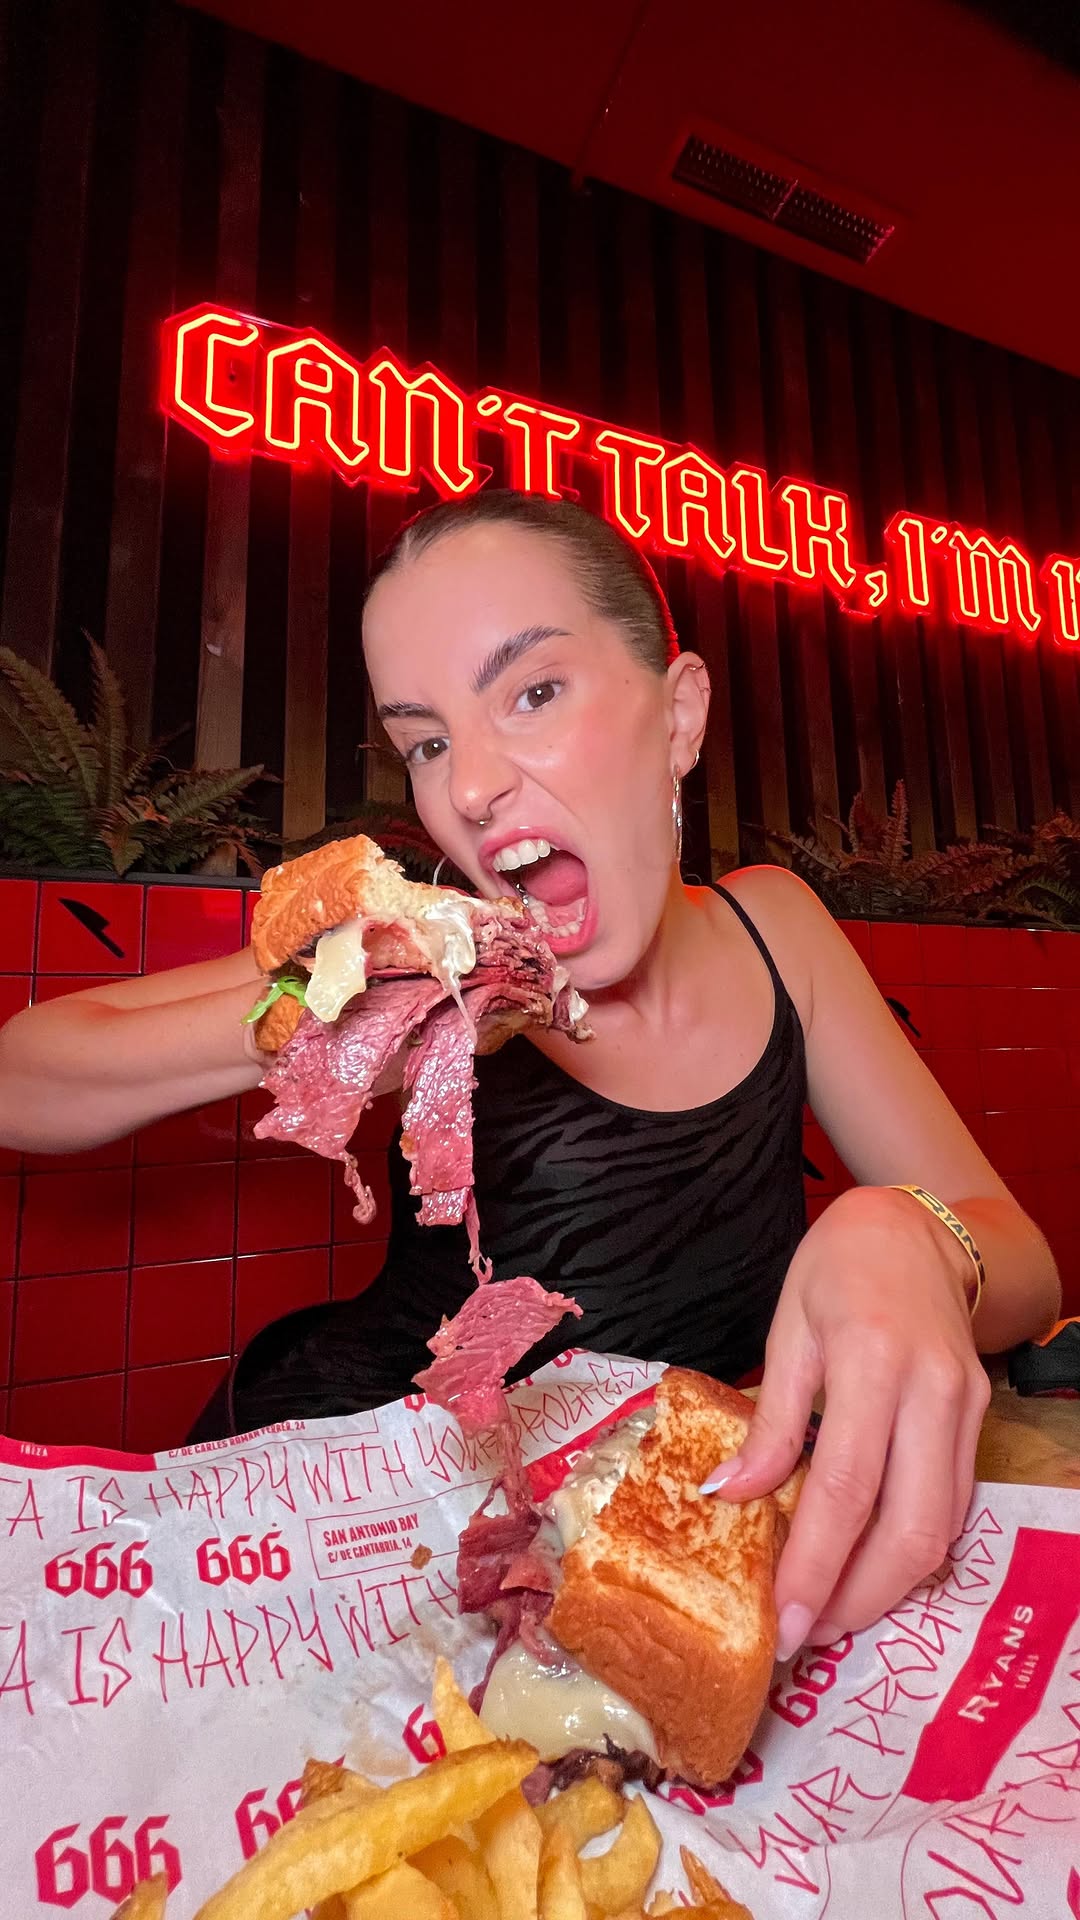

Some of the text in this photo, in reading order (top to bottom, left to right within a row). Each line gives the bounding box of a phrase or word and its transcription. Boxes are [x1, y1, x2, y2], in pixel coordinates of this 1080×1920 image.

[595, 430, 888, 608] TALK,
[66, 1475, 128, 1535] IS
[144, 1446, 297, 1520] HAPPY
[302, 1439, 414, 1506] WITH
[181, 1446, 193, 1457] DE
[194, 1440, 228, 1454] CARLES
[196, 1530, 291, 1586] 666
[323, 1512, 420, 1547] SAN ANTONIO BAY
[340, 1548, 352, 1561] DE
[402, 1536, 413, 1549] 14
[45, 1540, 153, 1599] 666
[61, 1616, 133, 1708] IS
[152, 1588, 334, 1703] HAPPY
[334, 1569, 458, 1658] WITH
[957, 1604, 1035, 1723] RYANS
[34, 1814, 182, 1910] 666
